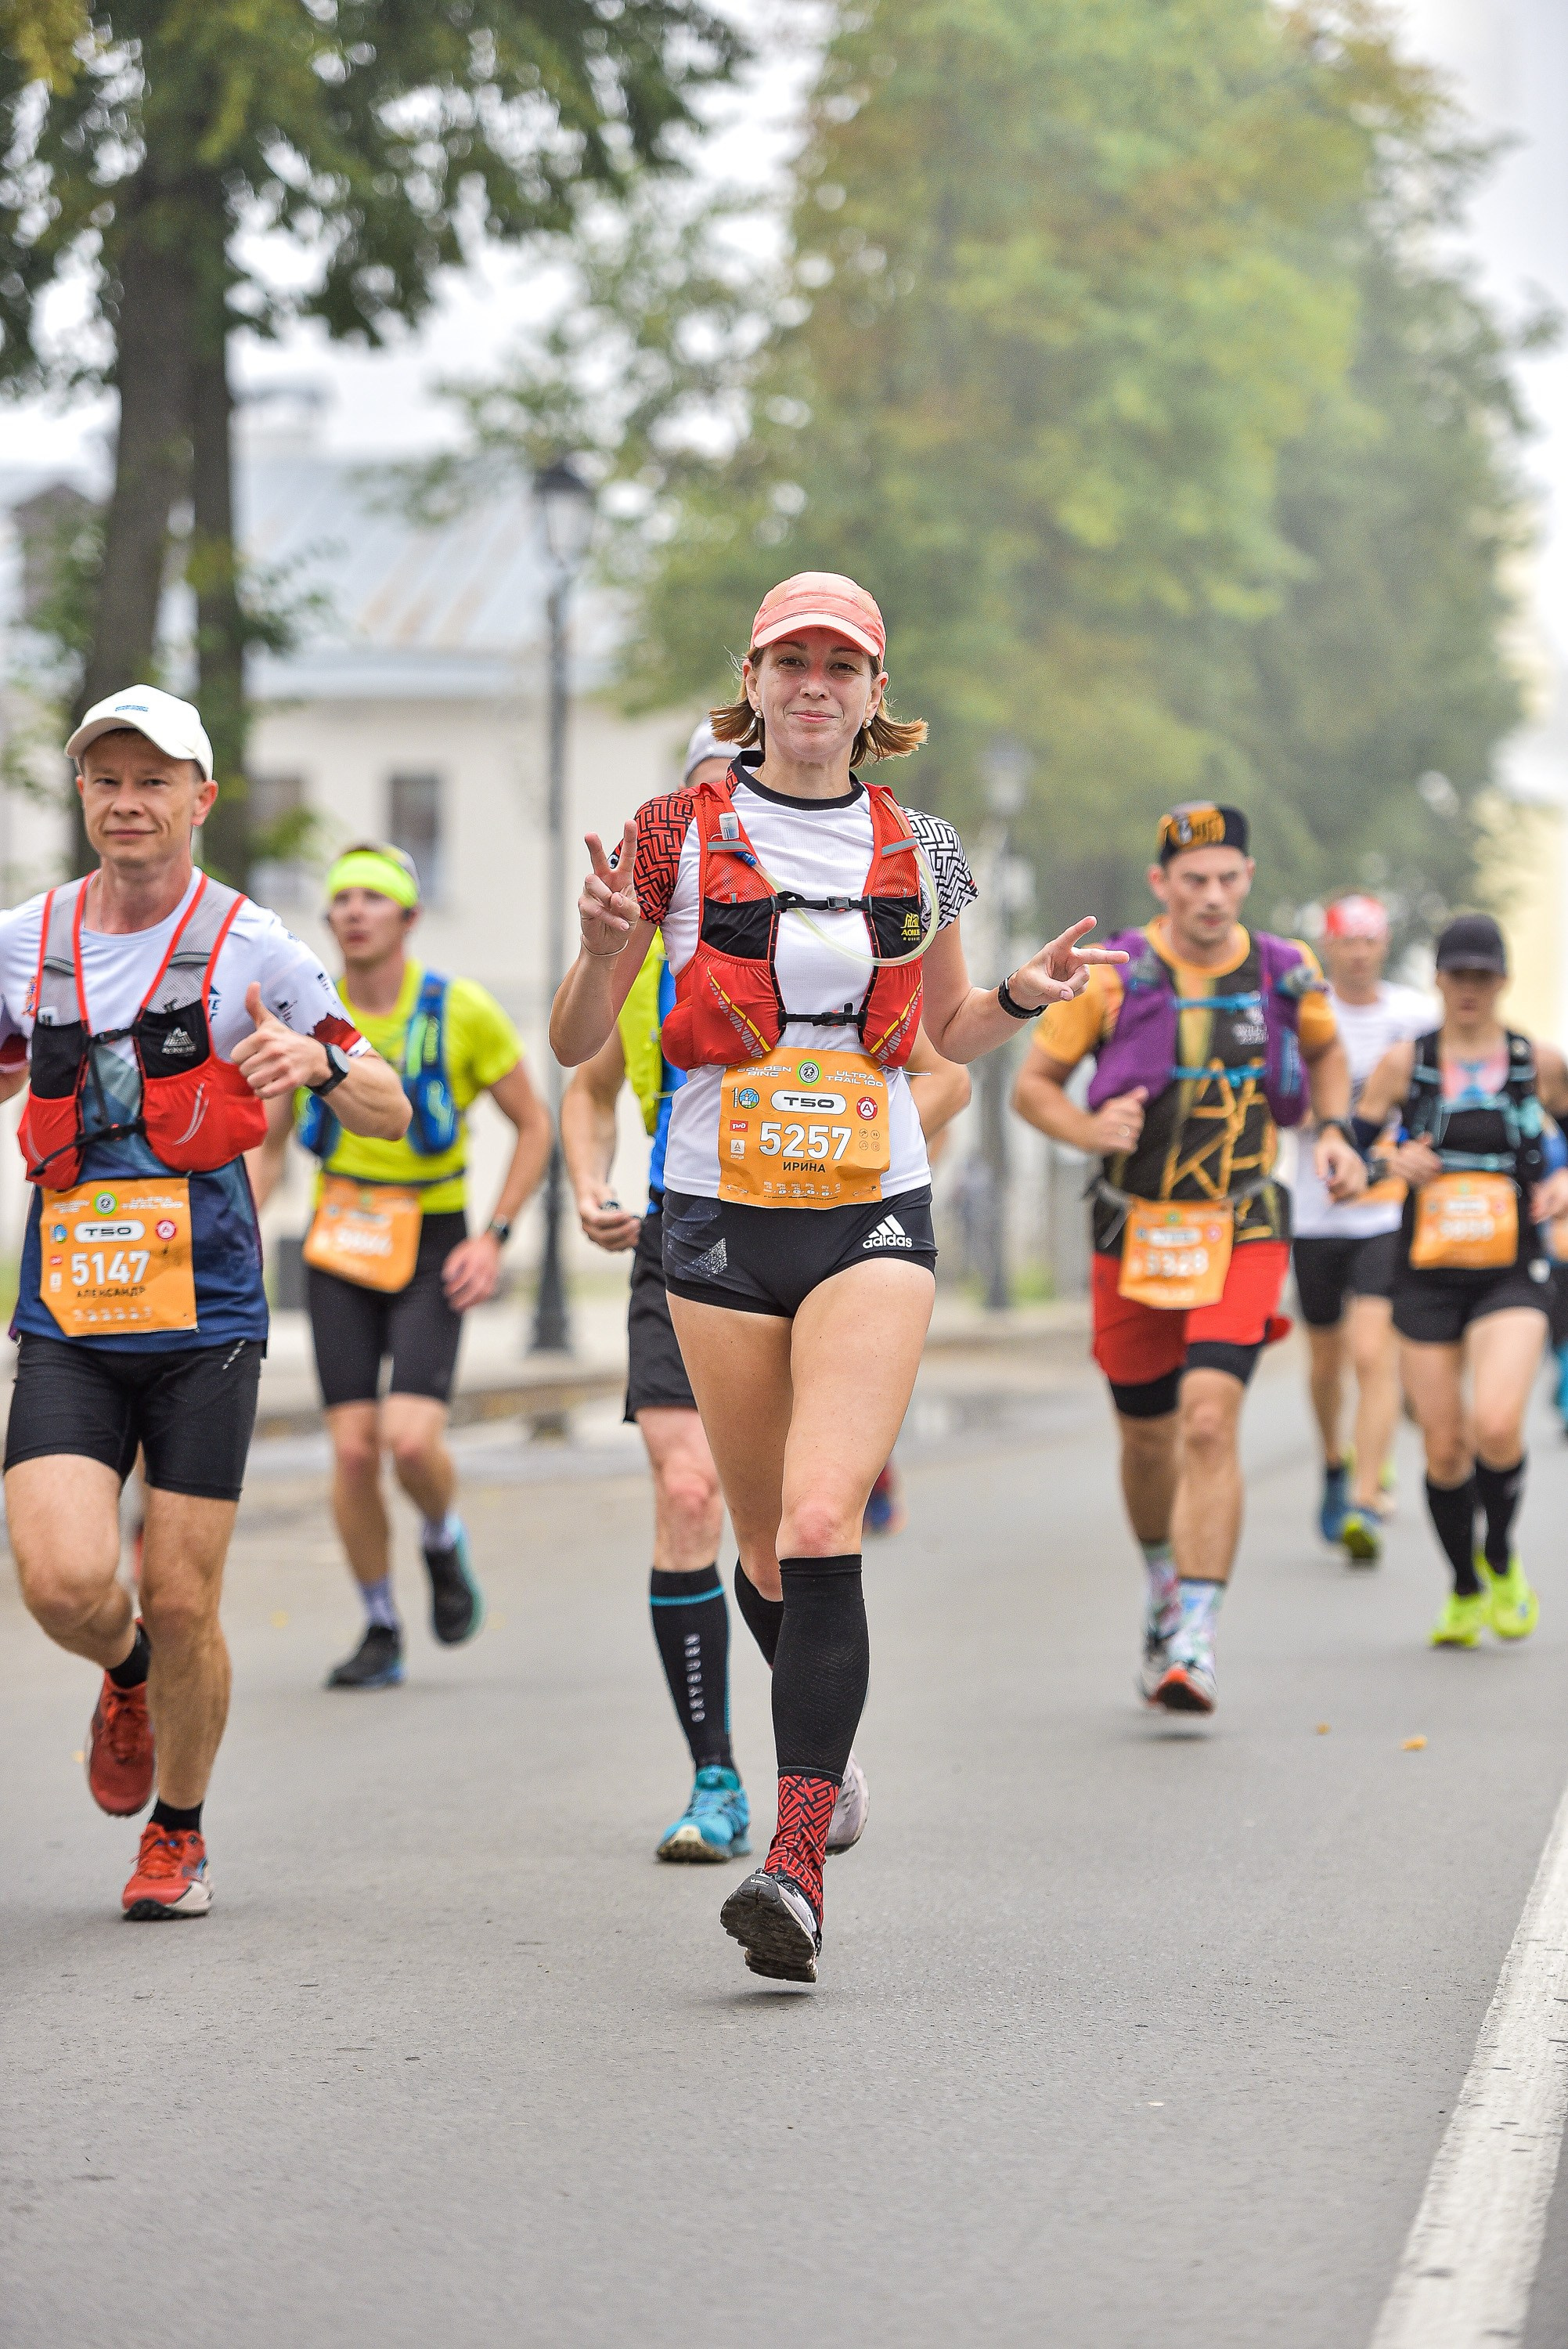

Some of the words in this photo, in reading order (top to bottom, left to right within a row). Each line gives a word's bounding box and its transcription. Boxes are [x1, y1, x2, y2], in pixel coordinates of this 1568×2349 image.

[825, 1075, 861, 1084] TRAIL
[863, 1079, 884, 1088] 100
[836, 1070, 875, 1081] ULTRA
[784, 1096, 834, 1109] T50
[759, 1121, 852, 1160] 5257
[783, 1161, 826, 1173] ИРИНА
[85, 1227, 132, 1236] T50
[862, 1234, 913, 1249] adidas
[71, 1250, 151, 1286] 5147
